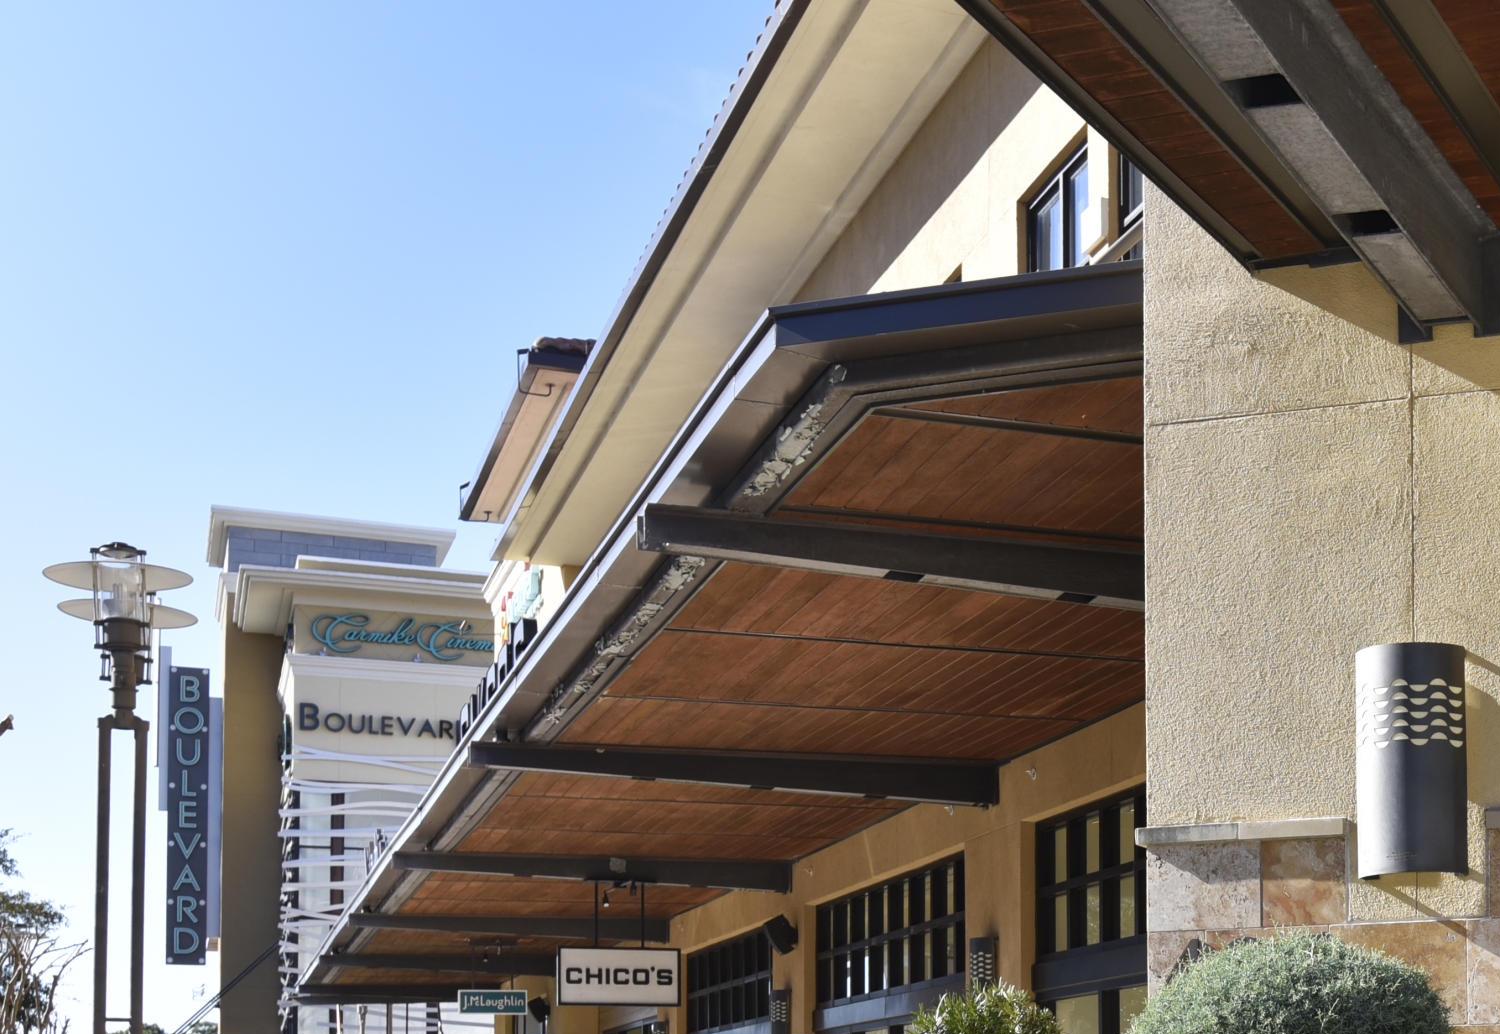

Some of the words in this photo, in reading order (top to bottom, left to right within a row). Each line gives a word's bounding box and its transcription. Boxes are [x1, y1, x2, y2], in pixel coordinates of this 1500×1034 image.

[312, 613, 415, 653] Carmike
[173, 675, 205, 954] BOULEVARD
[565, 966, 673, 985] CHICO'S
